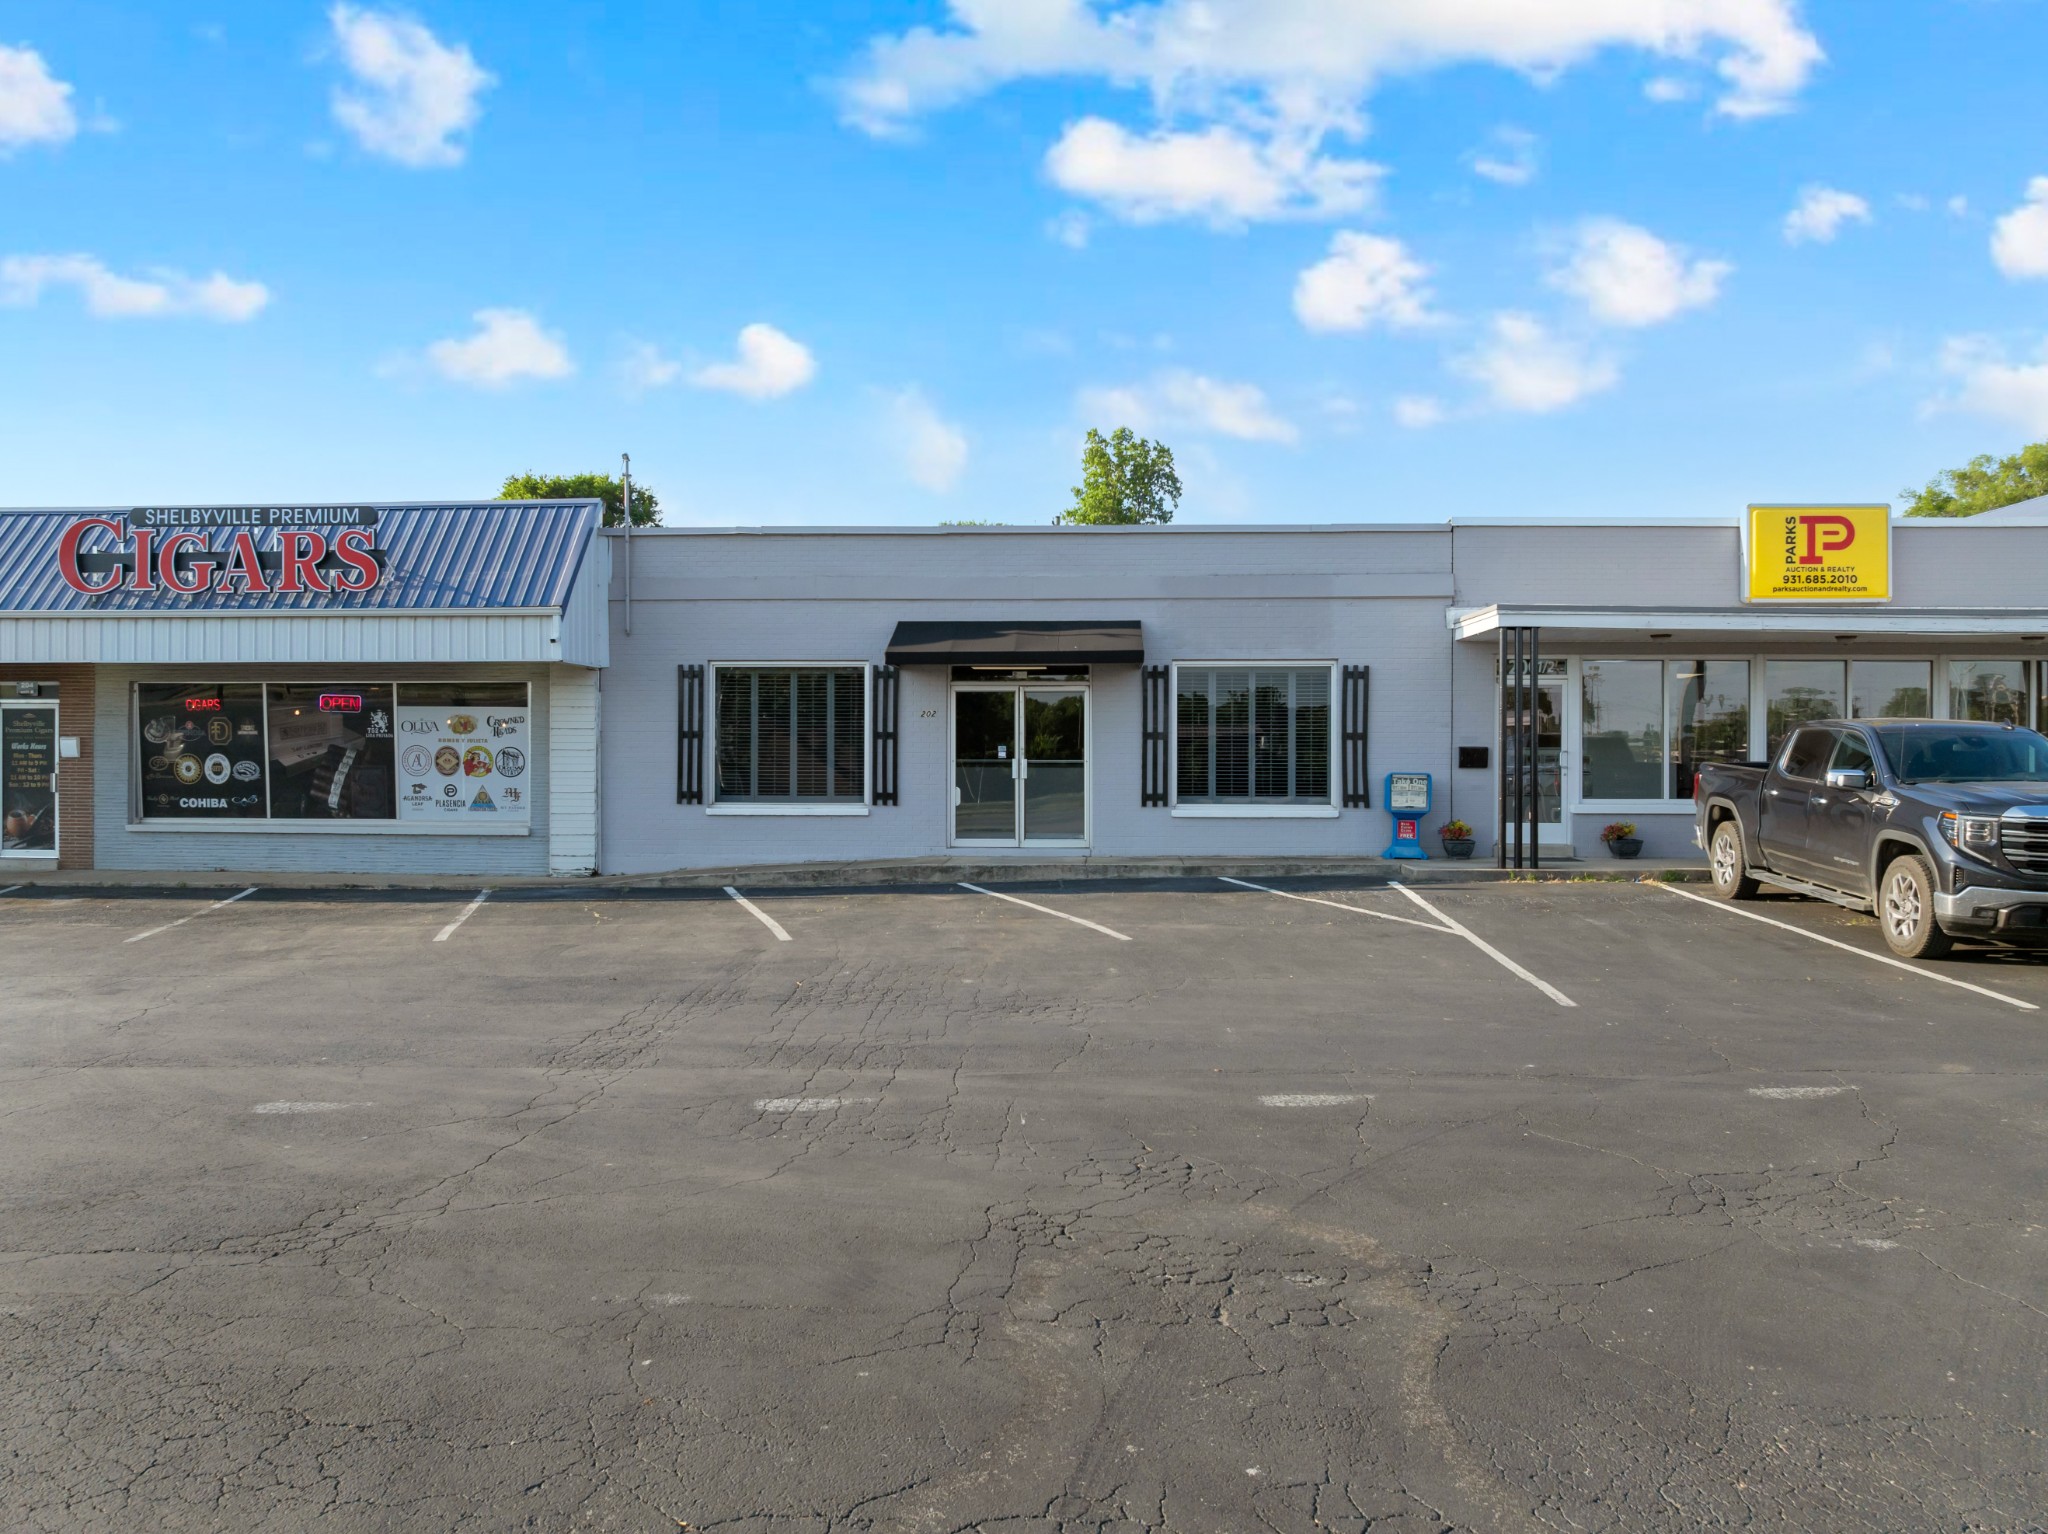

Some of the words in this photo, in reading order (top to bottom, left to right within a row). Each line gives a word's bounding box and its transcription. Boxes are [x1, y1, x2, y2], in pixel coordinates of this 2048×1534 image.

[145, 508, 261, 525] SHELBYVILLE
[269, 507, 360, 524] PREMIUM
[1785, 516, 1796, 564] PARKS
[58, 517, 380, 594] CIGARS
[1783, 574, 1858, 584] 931.685.2010
[1772, 585, 1867, 593] parksauctionandrealty.com
[185, 699, 221, 711] CIGARS
[321, 697, 360, 710] OPEN
[920, 710, 937, 718] 202
[180, 797, 228, 808] COHIBA
[435, 799, 466, 808] PLASENCIA
